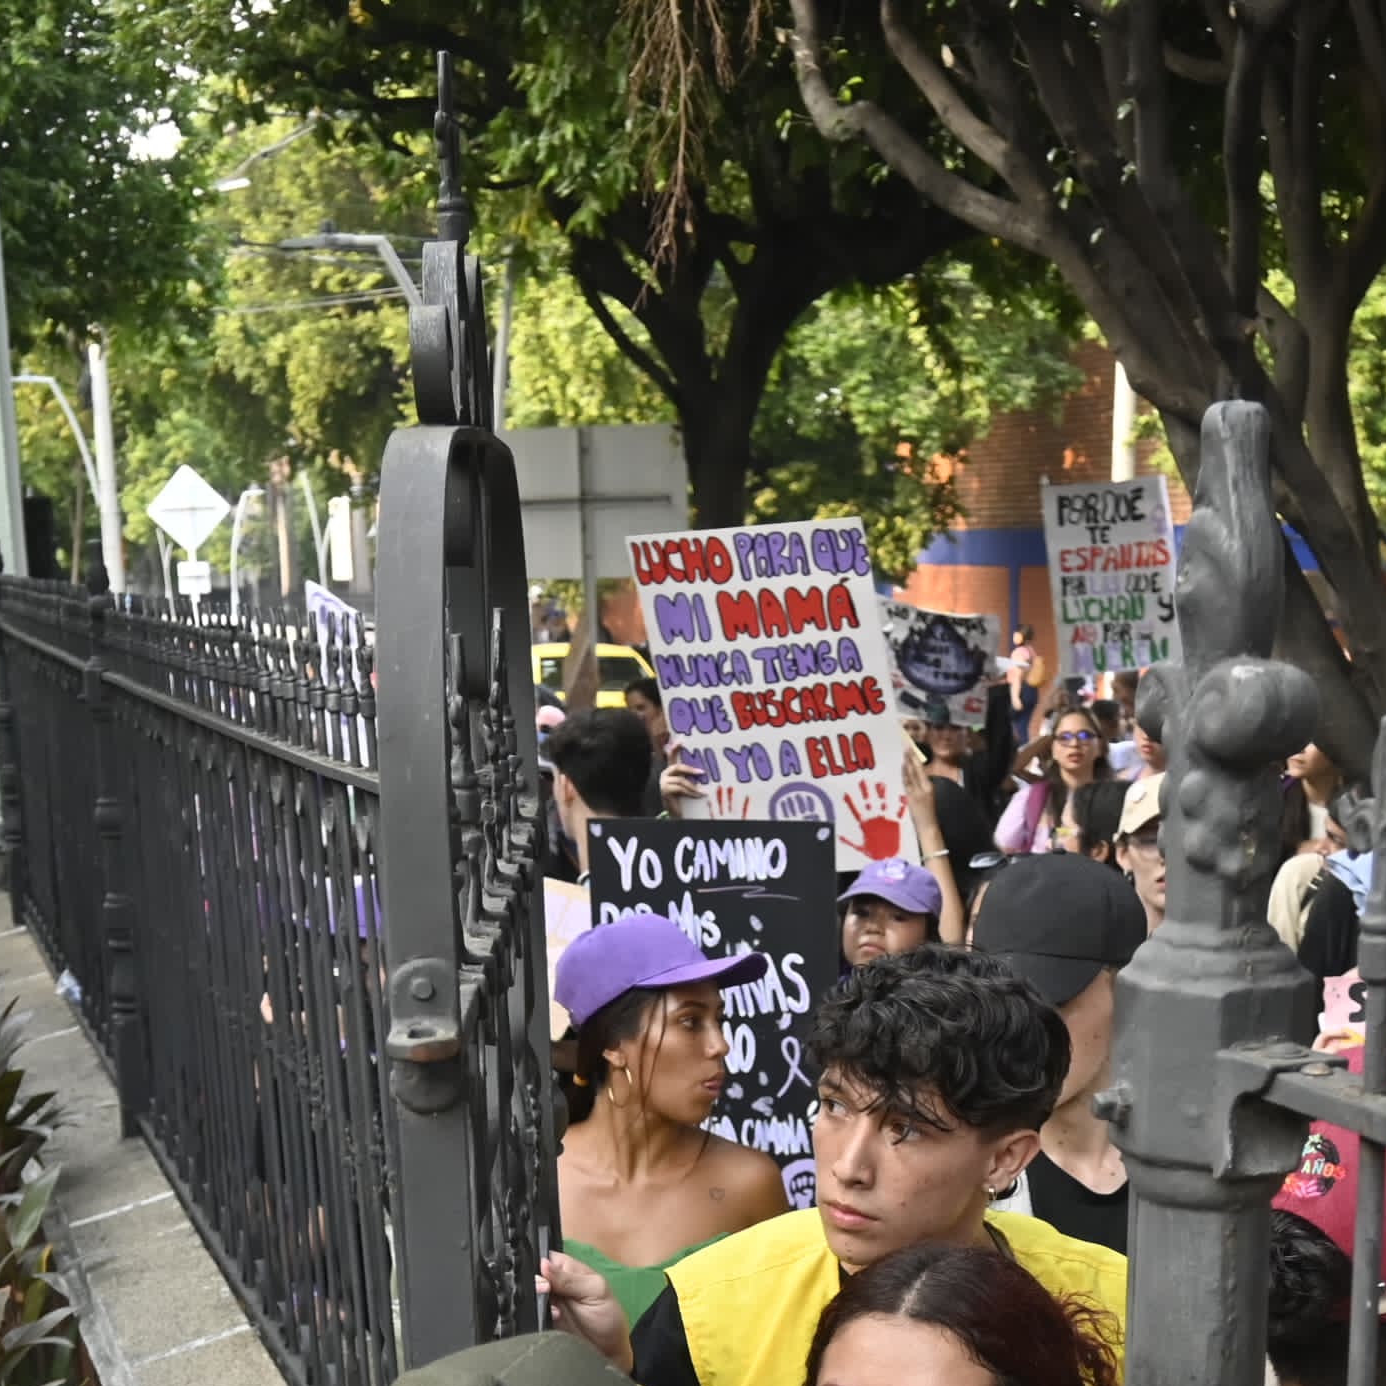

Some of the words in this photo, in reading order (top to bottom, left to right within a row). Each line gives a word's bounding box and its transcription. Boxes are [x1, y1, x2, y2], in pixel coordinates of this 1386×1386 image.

[630, 536, 733, 585] LUCHO
[733, 532, 810, 581] PARA
[812, 527, 870, 576] QUE
[1059, 538, 1171, 572] ESPANTAS
[1085, 525, 1111, 544] TE
[655, 592, 711, 645] MI
[716, 577, 860, 641] MAMÁ
[1158, 592, 1174, 622] Y
[655, 650, 752, 689] NUNCA
[752, 637, 862, 684] TENGA
[668, 695, 732, 736] QUE
[730, 676, 886, 730] BUSCARME
[679, 745, 721, 784] NI
[723, 742, 773, 783] YO
[779, 740, 801, 777] A
[805, 731, 875, 778] ELLA
[606, 836, 662, 892] YO
[674, 836, 787, 883] CAMINO
